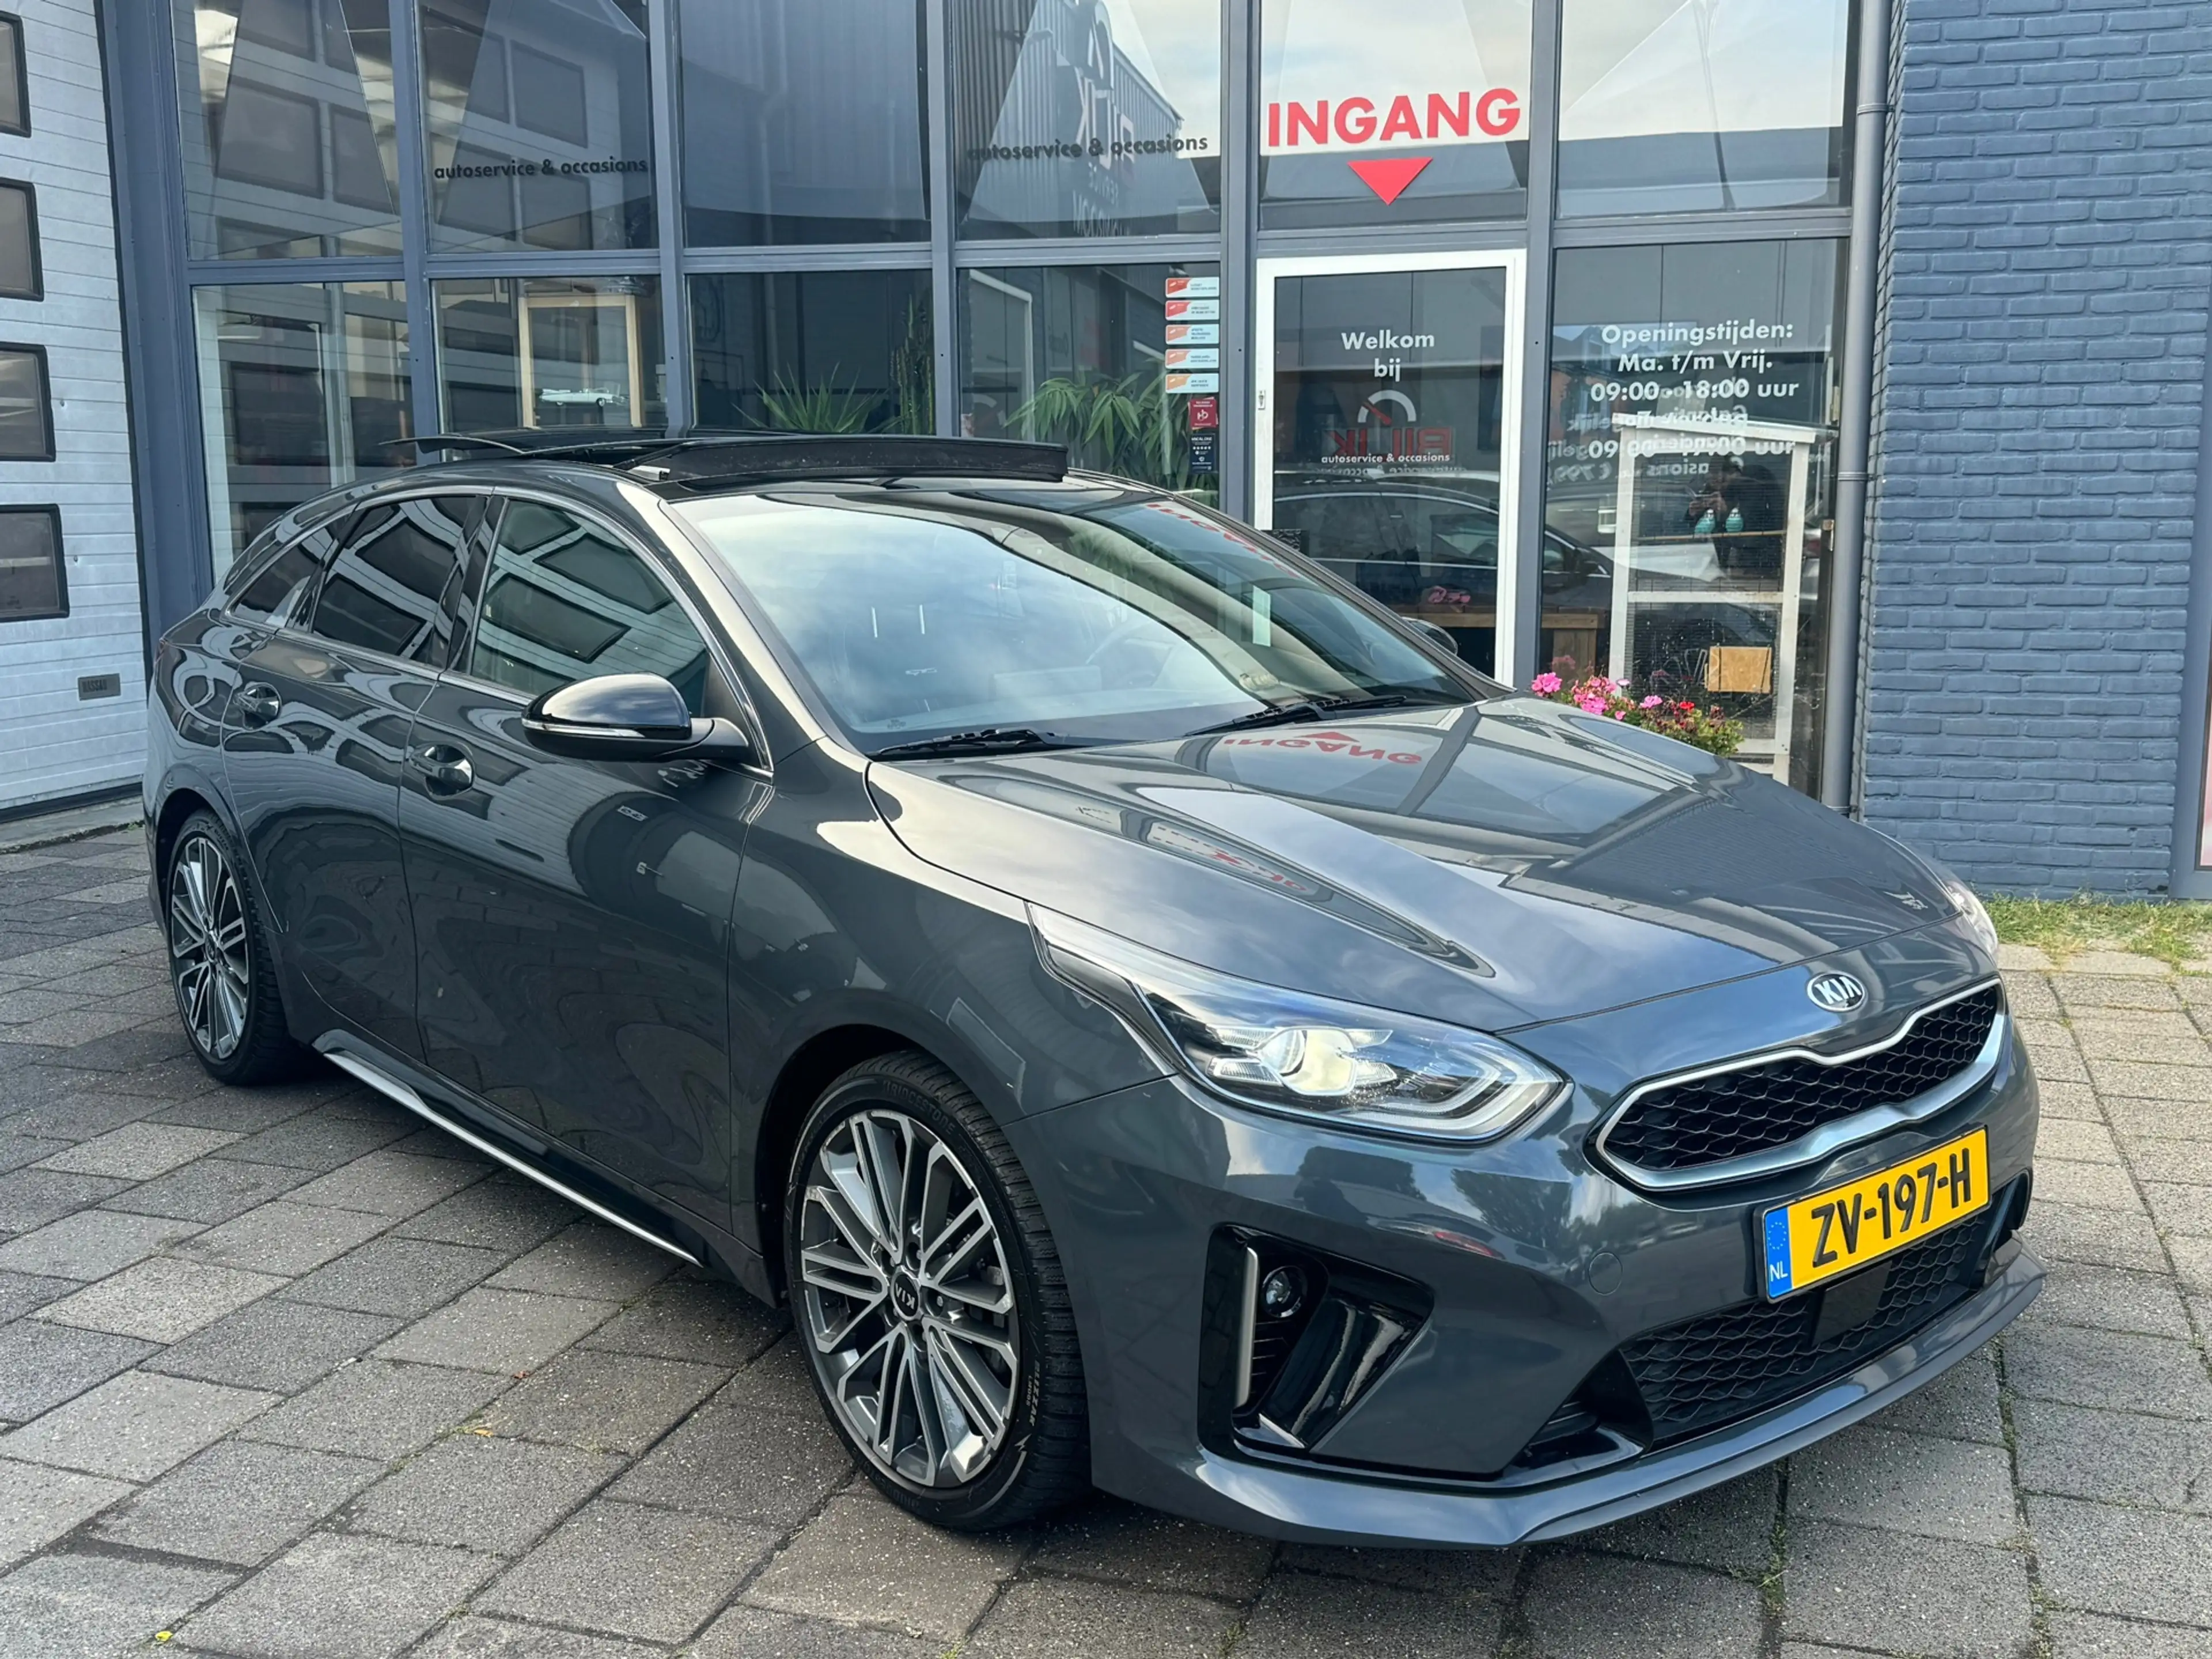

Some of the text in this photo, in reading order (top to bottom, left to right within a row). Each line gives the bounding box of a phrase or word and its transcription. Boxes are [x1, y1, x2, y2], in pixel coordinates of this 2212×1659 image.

[1268, 88, 1521, 147] INGANG
[967, 134, 1209, 160] autoservice & occasions
[434, 156, 647, 180] autoservice & occasions
[1341, 329, 1435, 350] Welkom
[1601, 319, 1794, 347] Openingstijden:
[1374, 358, 1402, 382] bij
[1618, 349, 1773, 374] Ma. t/m Vrij.
[1590, 381, 1660, 402] 09:00
[1683, 378, 1750, 399] 18:00
[1757, 381, 1799, 398] uur
[1321, 452, 1450, 464] autoservice & occasions
[1814, 976, 1862, 1005] KIA
[1811, 1148, 1972, 1268] ZV-197-H
[1770, 1262, 1788, 1283] NL
[895, 1283, 915, 1309] KIA
